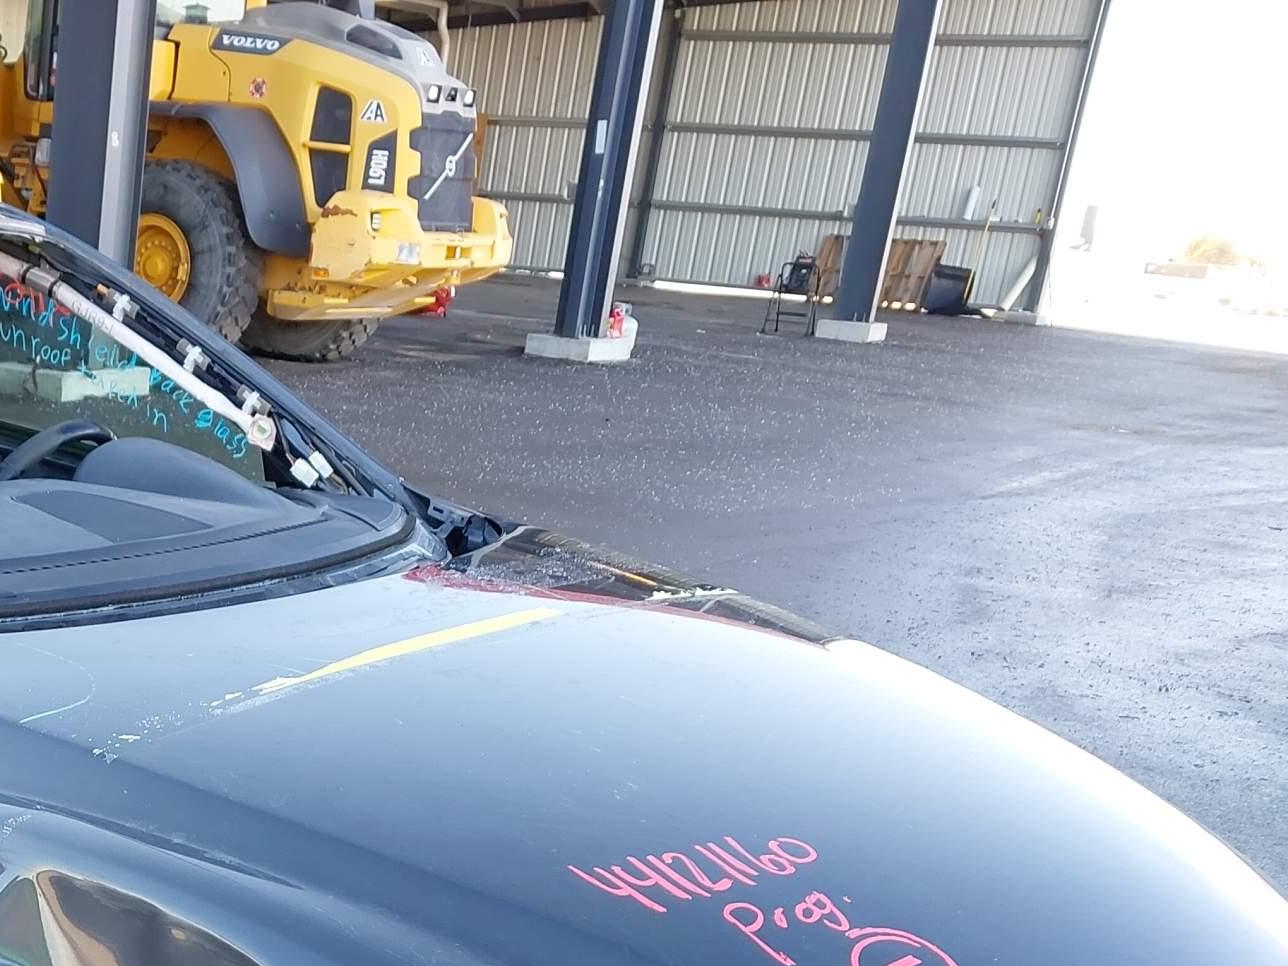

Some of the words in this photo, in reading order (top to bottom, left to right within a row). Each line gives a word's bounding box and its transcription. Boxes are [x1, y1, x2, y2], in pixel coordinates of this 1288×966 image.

[222, 34, 280, 51] VOLVO
[368, 149, 390, 185] L90H
[568, 835, 818, 913] 44121160
